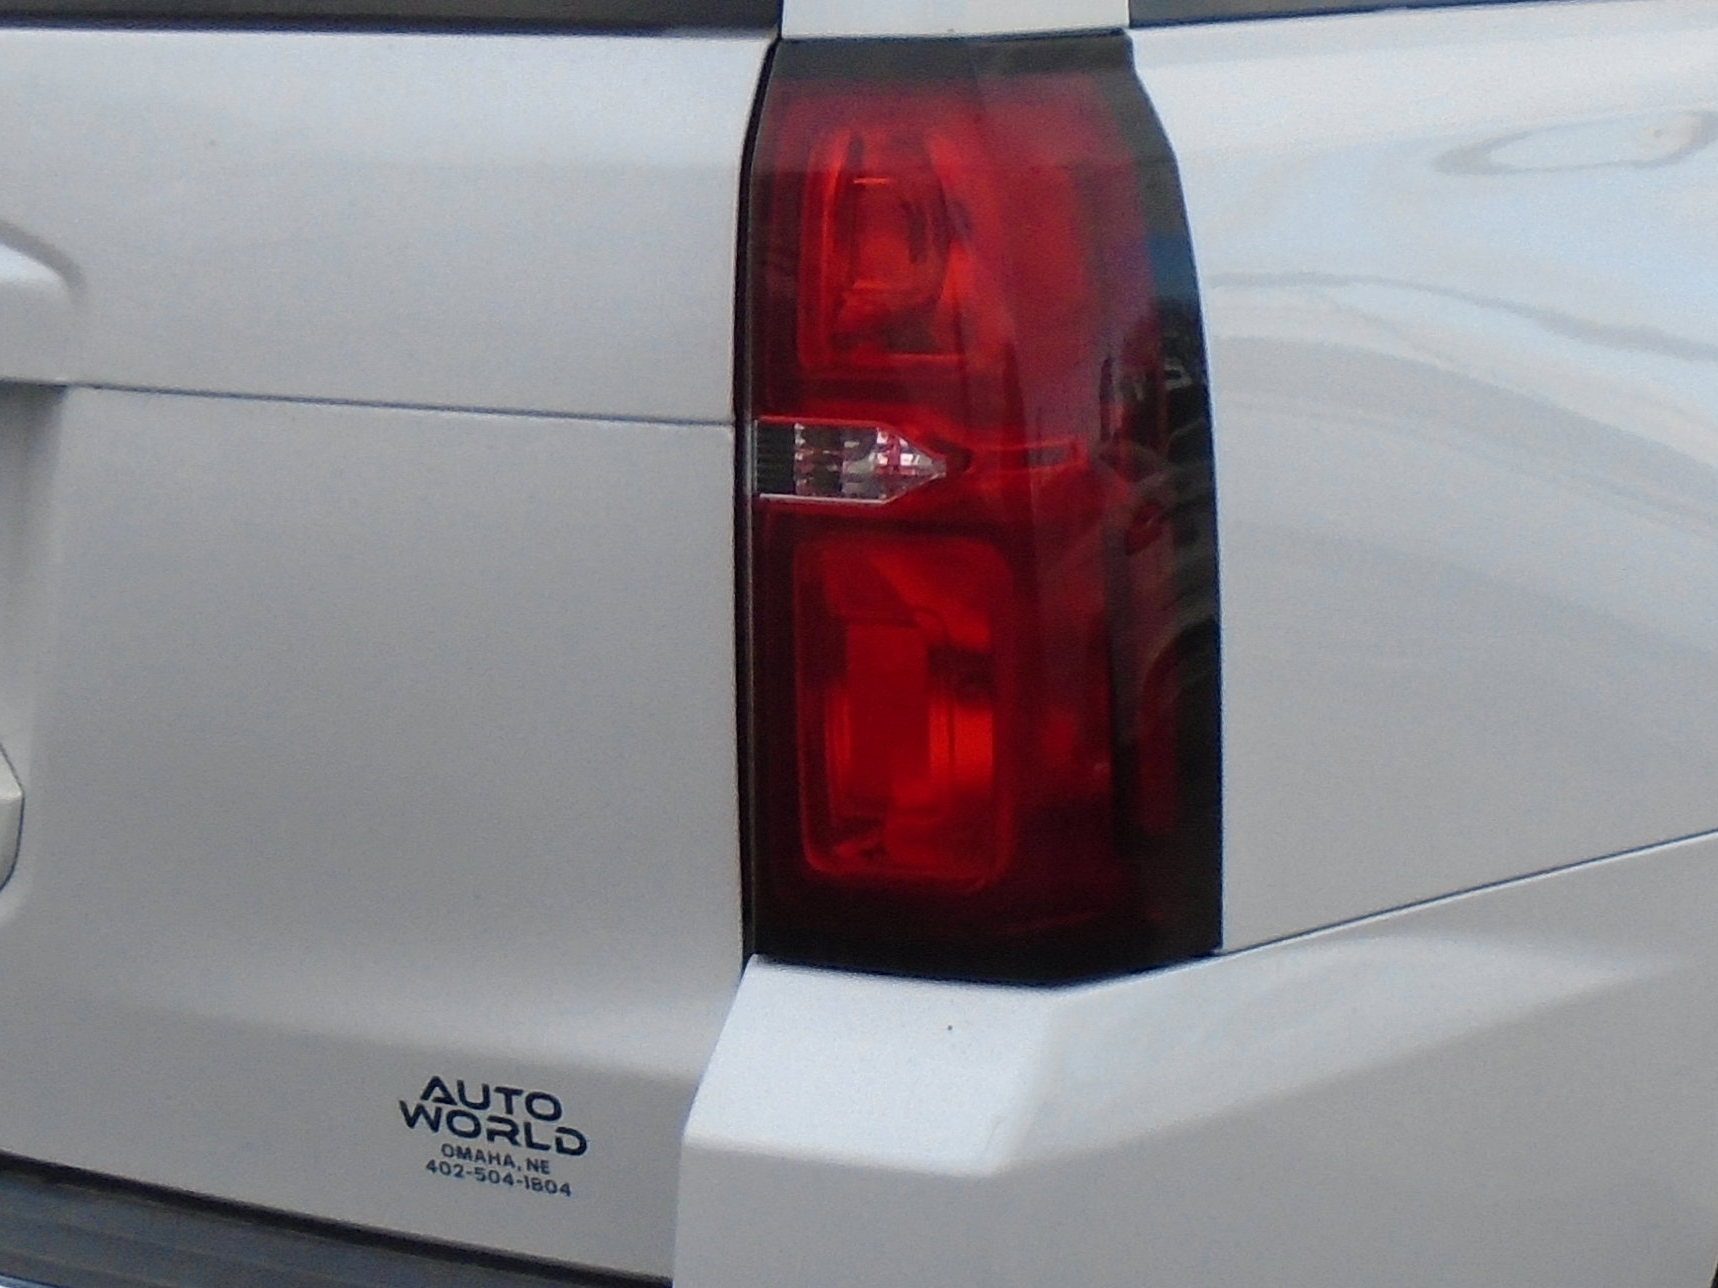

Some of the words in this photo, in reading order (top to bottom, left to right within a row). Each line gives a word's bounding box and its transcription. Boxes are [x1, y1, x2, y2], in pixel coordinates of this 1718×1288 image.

[420, 1076, 563, 1121] AUTO
[399, 1100, 587, 1156] WORLD
[426, 1159, 572, 1197] 402-504-1804
[441, 1143, 522, 1172] OMAHA,
[526, 1158, 551, 1174] NE
